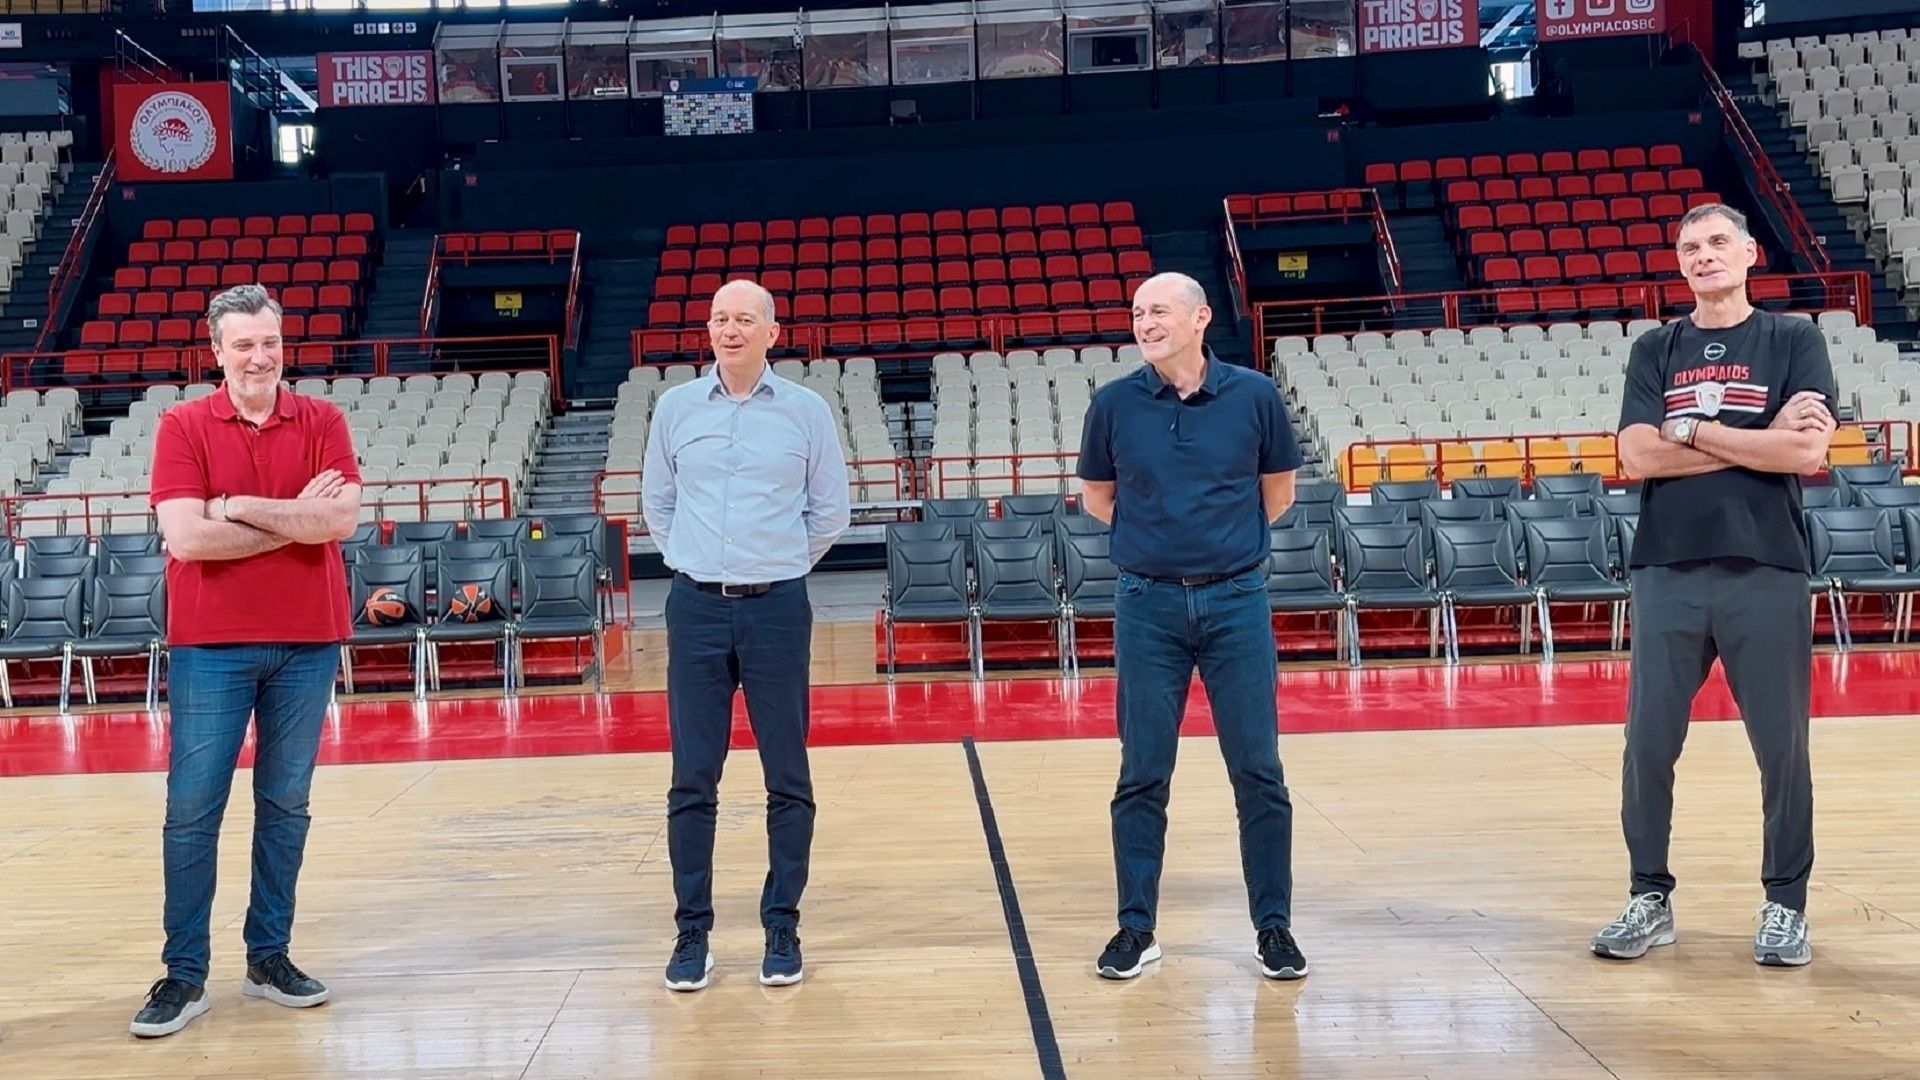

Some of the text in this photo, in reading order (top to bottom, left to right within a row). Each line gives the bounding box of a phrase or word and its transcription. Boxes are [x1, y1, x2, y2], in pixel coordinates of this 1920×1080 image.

[1363, 0, 1463, 24] THIS IS
[1364, 20, 1464, 50] PIRAEUS
[1546, 18, 1655, 36] @OLYMPIACOSBC
[332, 55, 426, 80] THIS IS
[333, 80, 427, 105] PIRAEUS
[139, 97, 206, 125] ΟΛΥΜΠΙΑΚΟΣ
